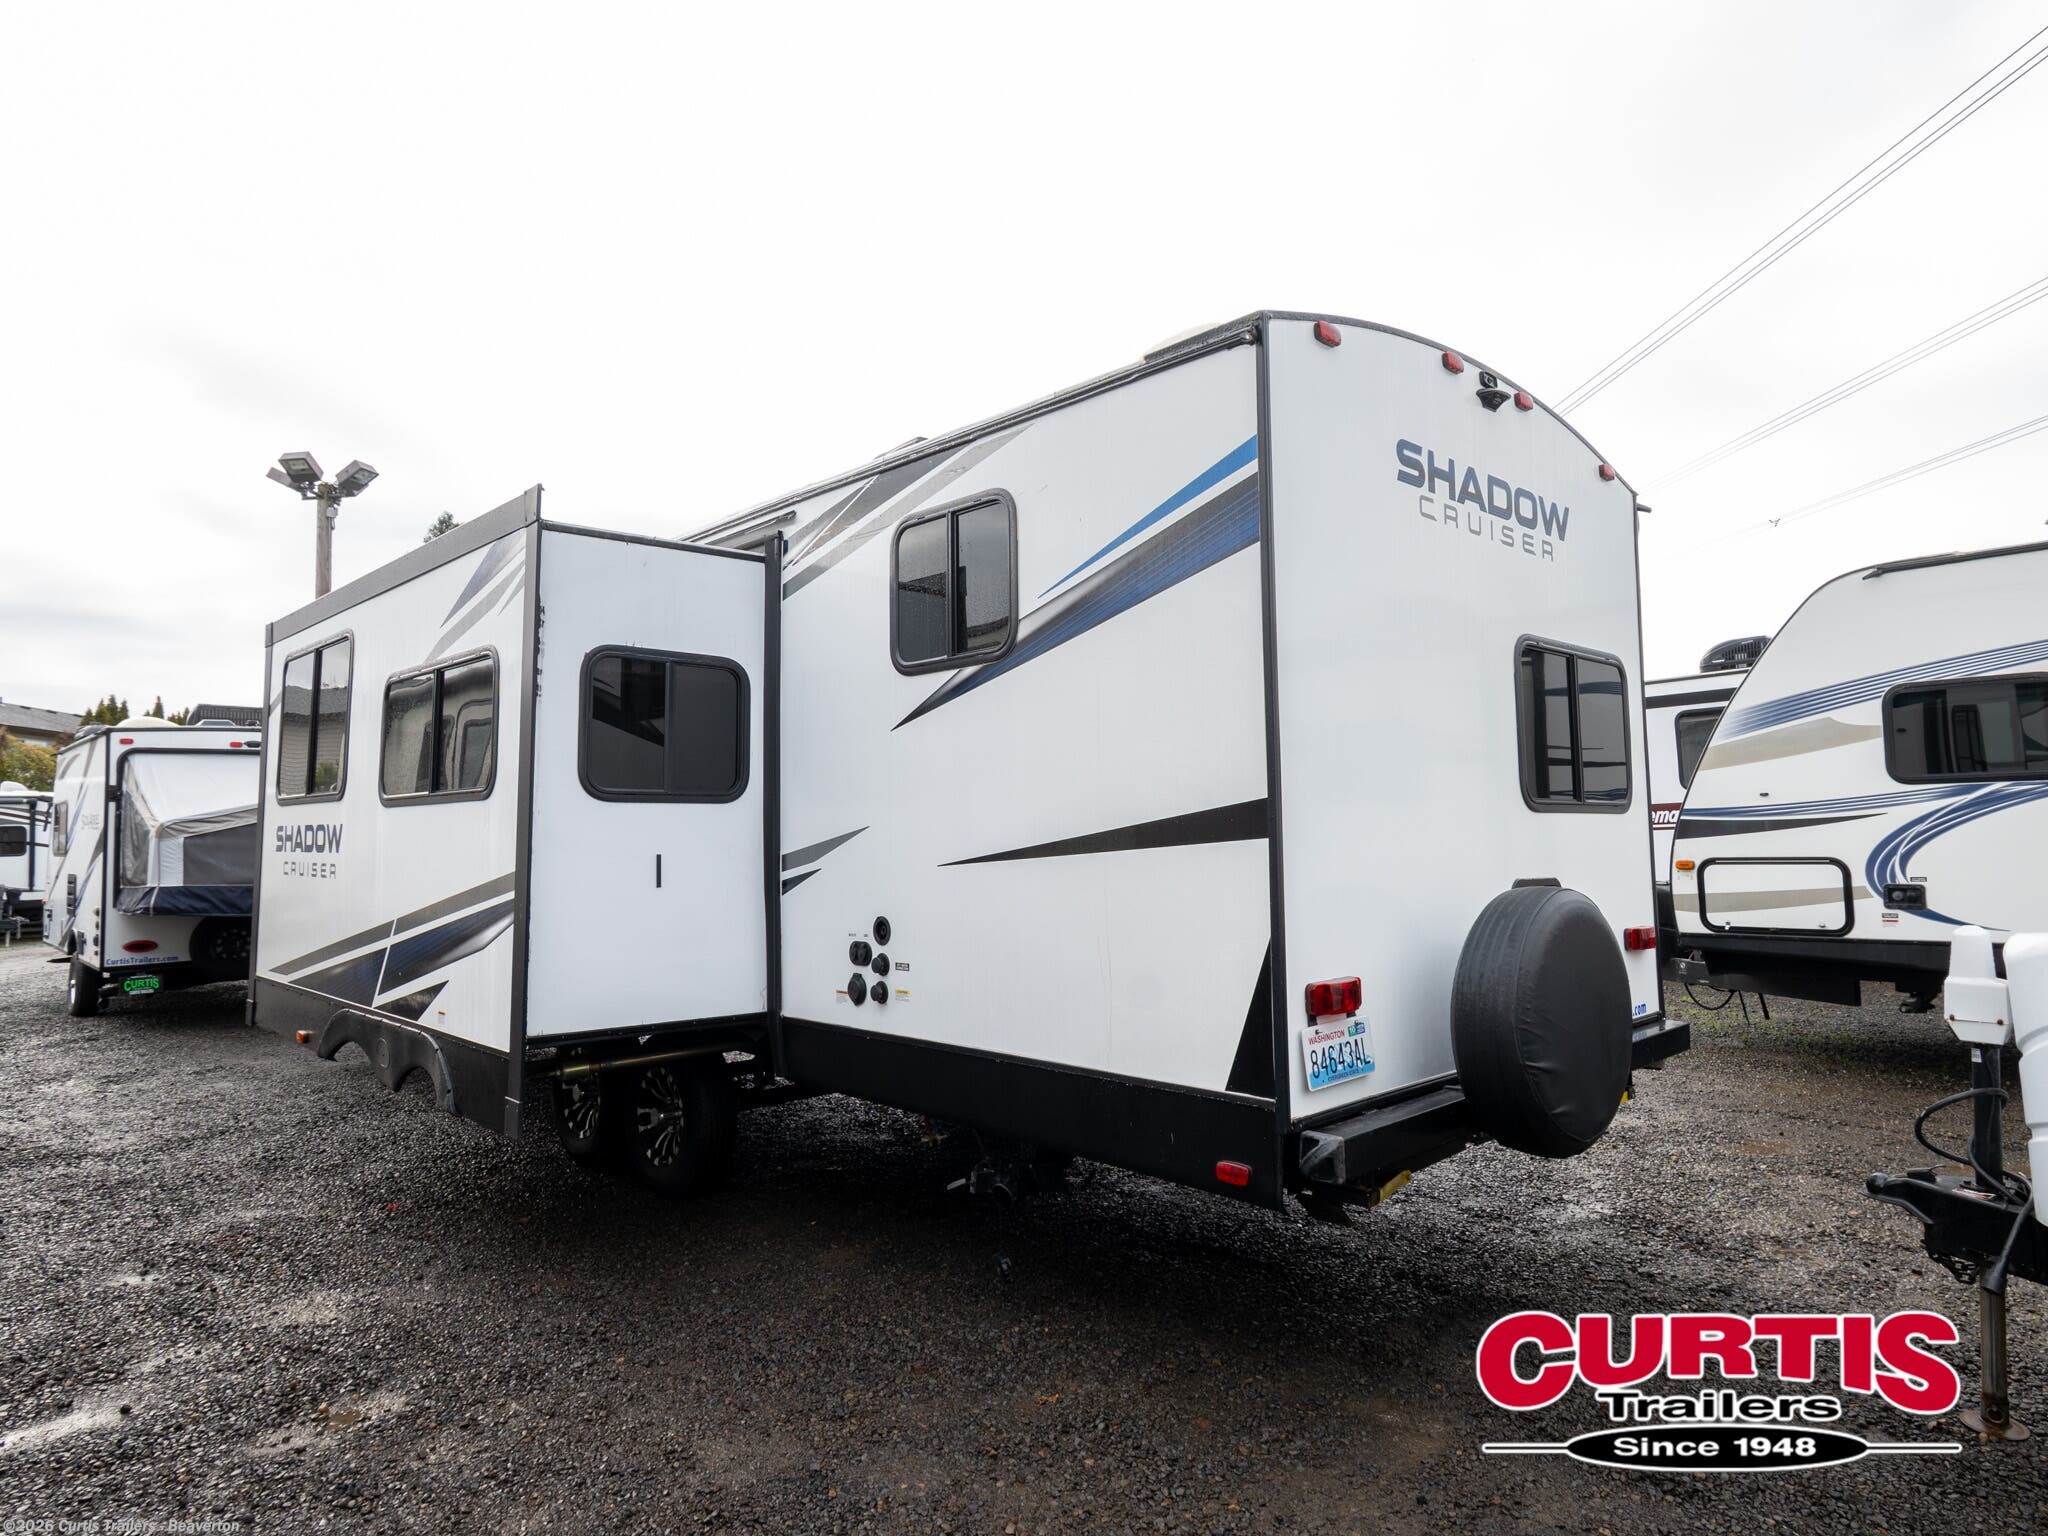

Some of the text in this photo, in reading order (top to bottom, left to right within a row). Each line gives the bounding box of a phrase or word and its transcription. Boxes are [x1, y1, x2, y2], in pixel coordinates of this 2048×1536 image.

[1396, 438, 1570, 542] SHADOW
[1419, 494, 1554, 562] CRUISER
[275, 824, 343, 853] SHADOW
[283, 860, 337, 880] CRUISER
[106, 956, 178, 966] CurtisTrailers.com
[123, 978, 160, 992] CURTIS
[1308, 1029, 1345, 1045] WASHINGTON
[1310, 1037, 1371, 1079] 84643AL
